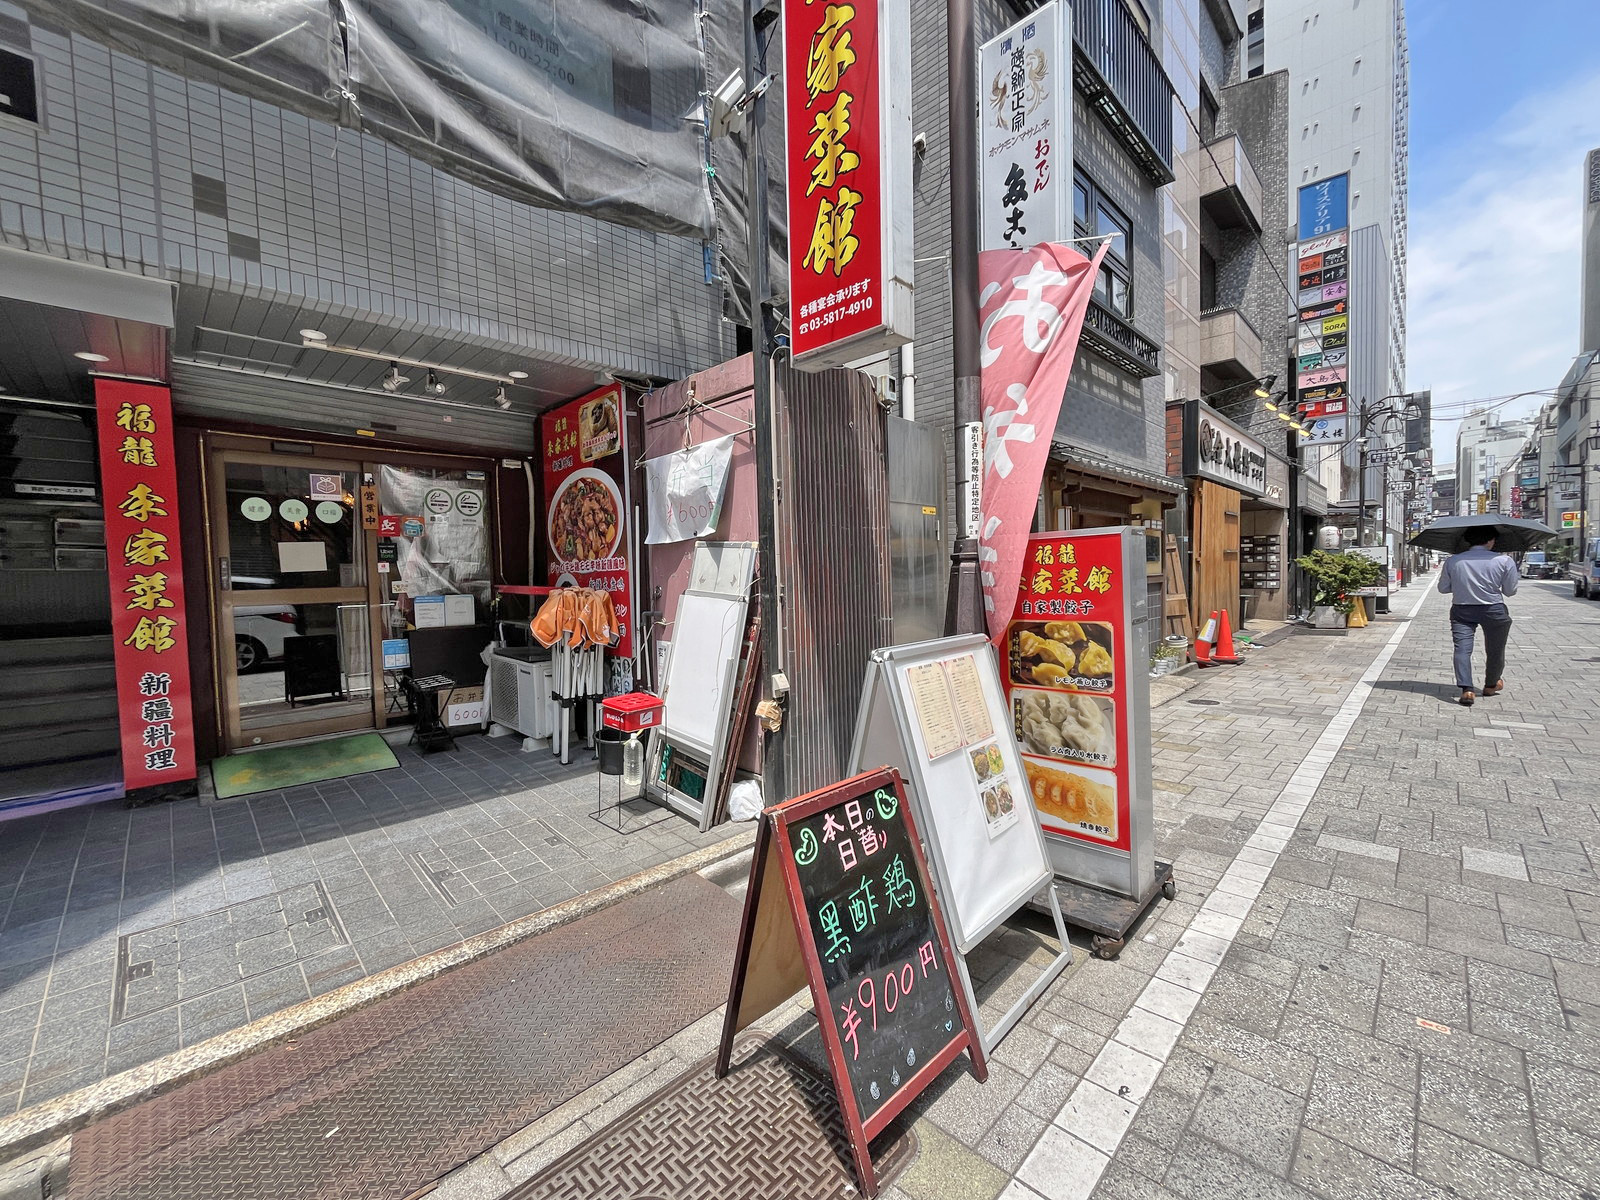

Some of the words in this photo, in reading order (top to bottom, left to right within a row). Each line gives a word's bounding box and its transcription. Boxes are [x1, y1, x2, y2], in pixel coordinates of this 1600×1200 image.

[484, 25, 575, 86] 11:00-22:00
[498, 11, 560, 57] 営業時間
[803, 0, 863, 277] 家菜館
[1033, 138, 1050, 194] おでん
[800, 278, 871, 318] 各種宴会承ります
[809, 296, 873, 331] 03-5817-4910
[1324, 322, 1346, 332] SORA
[115, 402, 158, 467] 福龍
[971, 426, 980, 522] 客引き行為等防止特定地区
[363, 491, 376, 525] 営業中
[118, 483, 178, 655] 李家菜館
[1035, 543, 1077, 565] 福龍
[1022, 600, 1094, 615] 自家製餃子
[1055, 676, 1107, 688] レモン蒸し餃子
[138, 671, 178, 770] 新疆料理
[454, 709, 482, 721] 600
[1051, 746, 1108, 762] ラム肉入り水餃子
[822, 800, 874, 844] 本日の
[1080, 821, 1110, 834] 焼き餃子
[838, 825, 887, 872] 日替り
[819, 854, 916, 963] 黒酢鶏
[841, 940, 939, 1061] ¥900円
